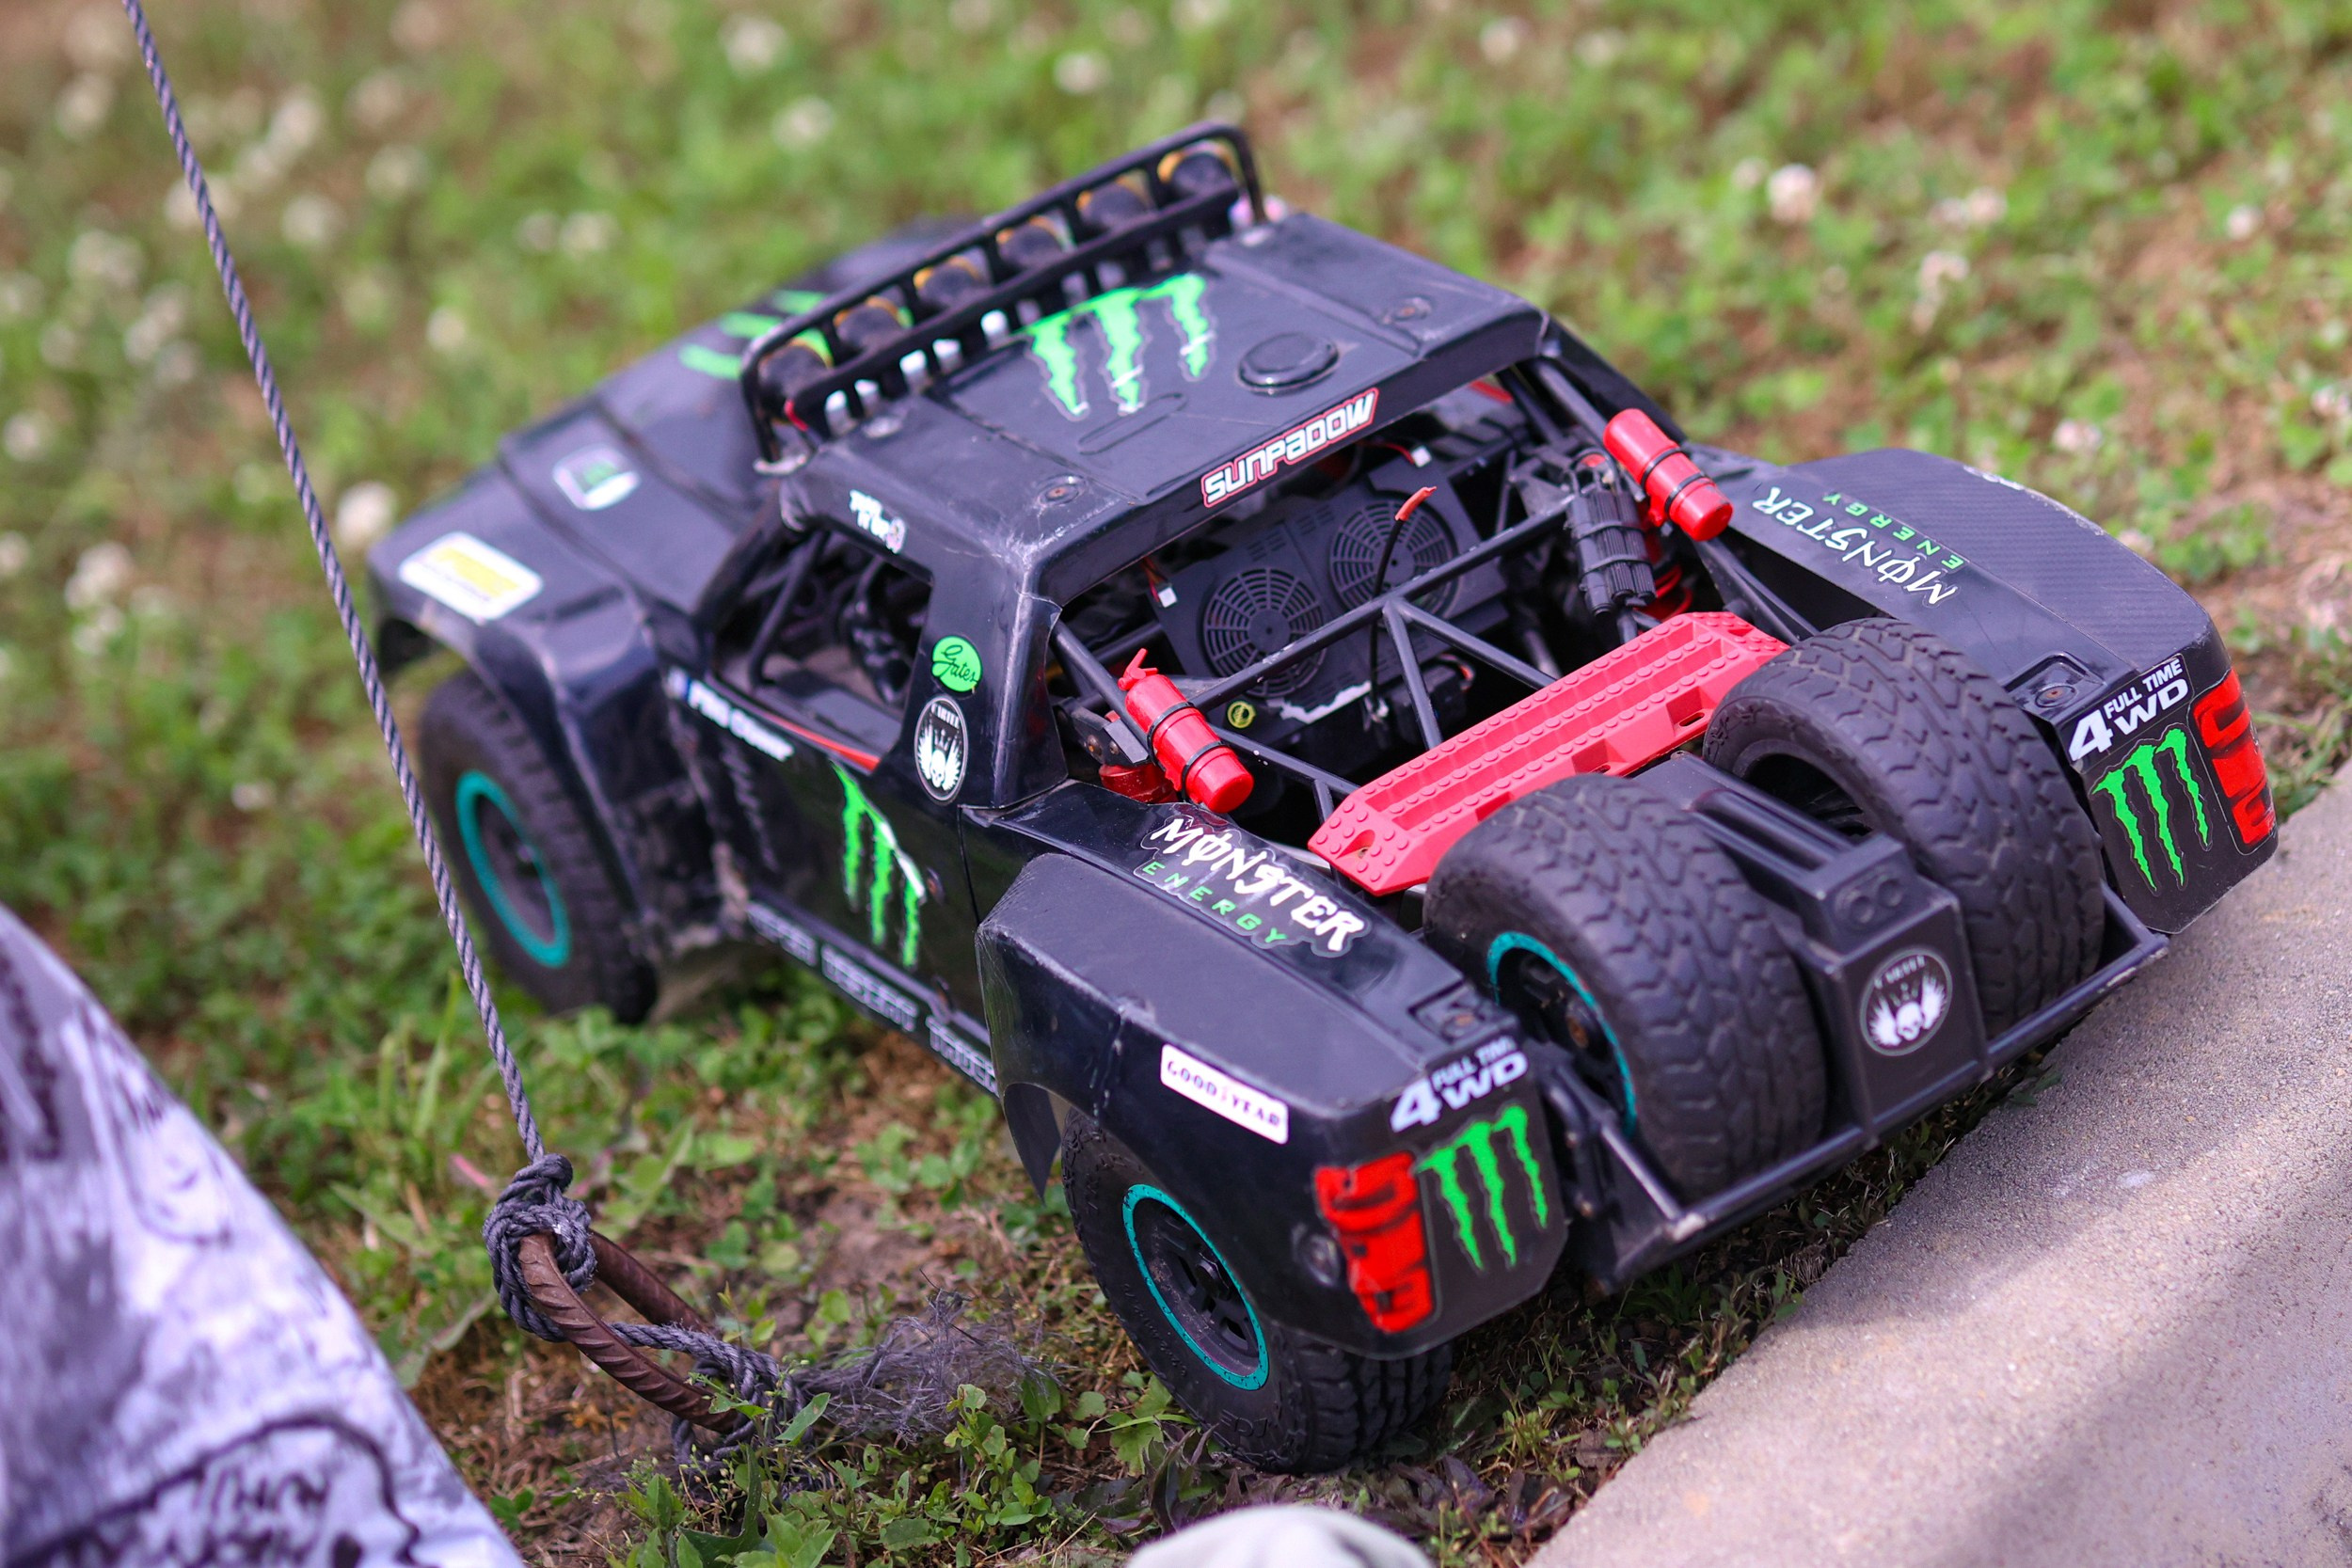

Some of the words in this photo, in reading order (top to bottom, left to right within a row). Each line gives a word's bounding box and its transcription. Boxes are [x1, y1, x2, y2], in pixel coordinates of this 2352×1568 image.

[1822, 491, 1964, 570] ENERGY
[2069, 677, 2189, 762] 4WD
[2103, 687, 2143, 720] FULL
[2141, 657, 2184, 692] TIME
[1141, 861, 1288, 943] ENERGY
[1390, 1051, 1530, 1133] 4WD
[1430, 1055, 1478, 1092] FULL
